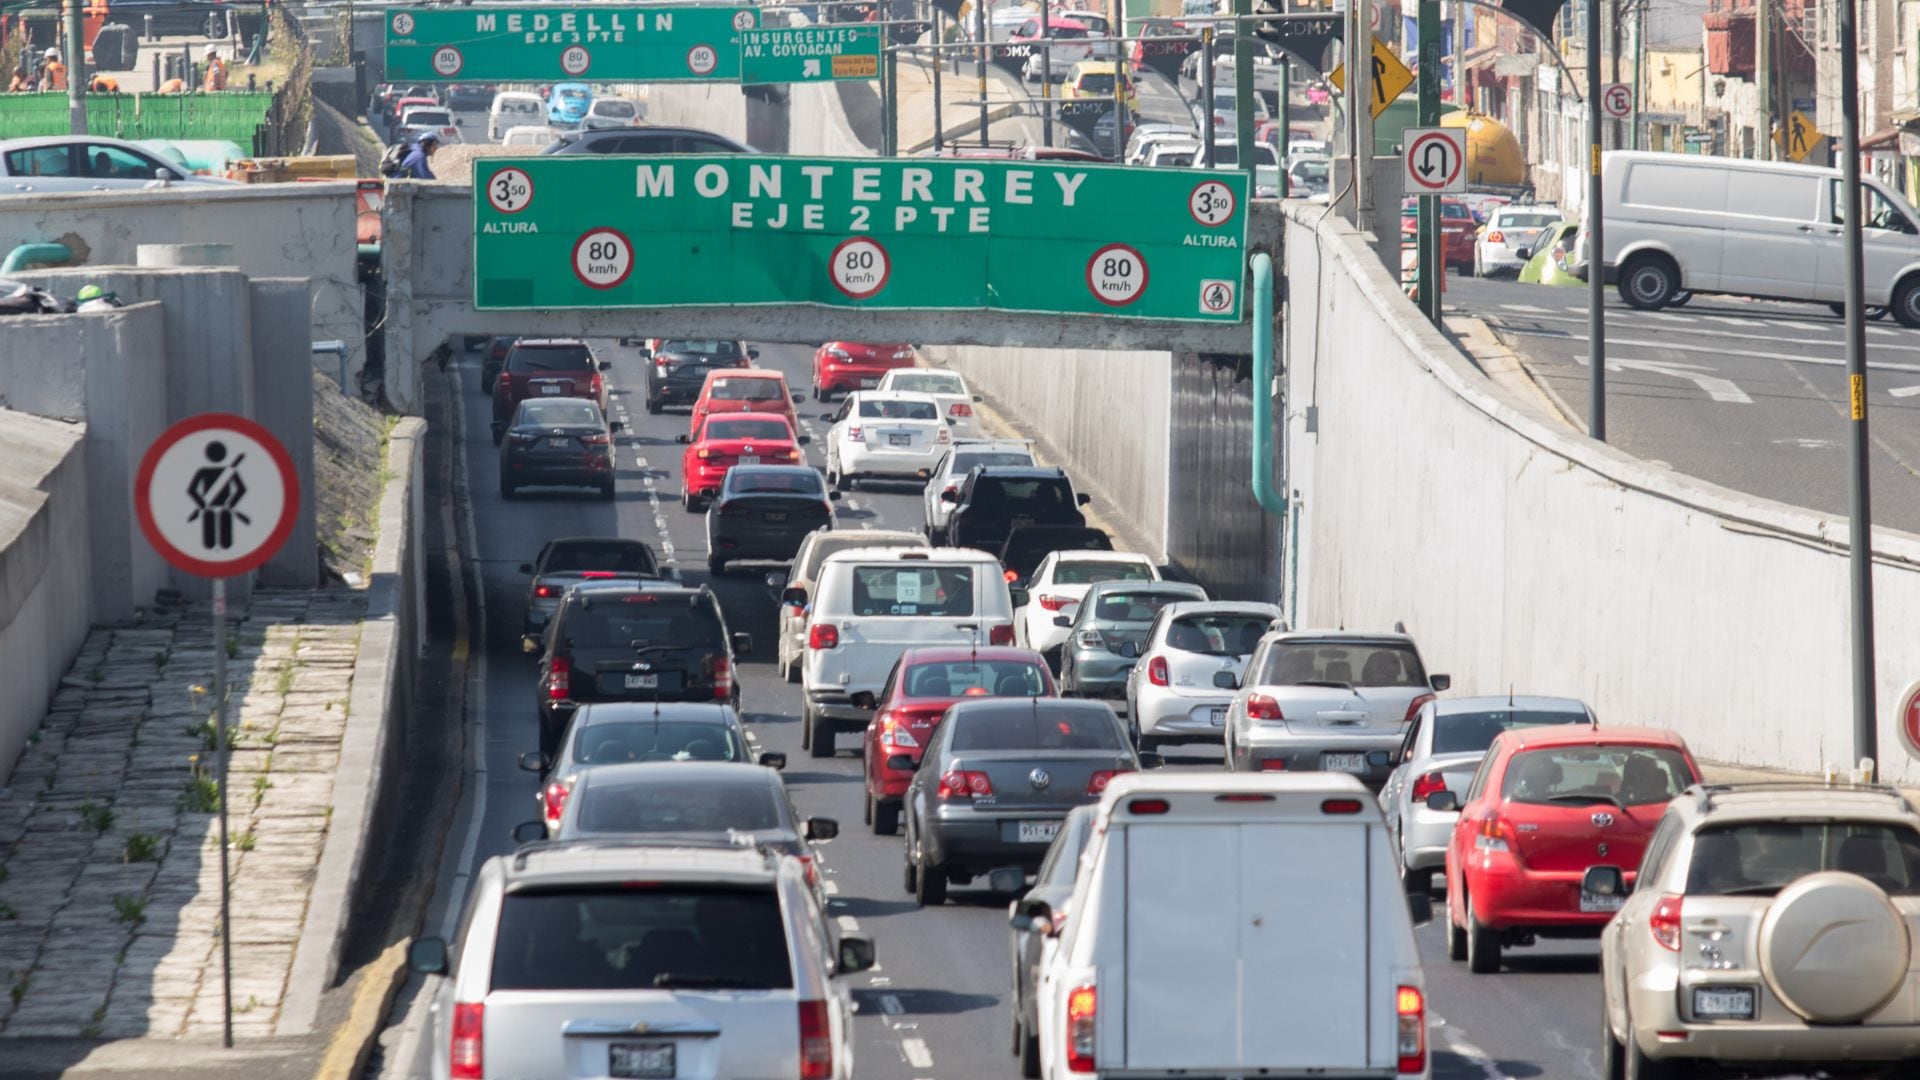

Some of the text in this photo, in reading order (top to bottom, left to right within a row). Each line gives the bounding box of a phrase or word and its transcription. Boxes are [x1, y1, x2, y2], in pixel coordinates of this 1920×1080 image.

[476, 13, 673, 32] MEDELLIN
[525, 31, 624, 44] EJE 3 PTE
[772, 43, 842, 57] COYOACAN
[994, 45, 1031, 57] CDMX
[1143, 42, 1189, 54] CDMX
[440, 52, 455, 63] 80
[569, 52, 583, 62] 80
[694, 51, 708, 61] 80
[1062, 103, 1103, 115] CDMX
[636, 164, 1088, 207] MONTERREY
[732, 202, 990, 232] EJE 2 PTE
[483, 222, 538, 233] ALTURA
[1183, 234, 1237, 248] ALTURA
[589, 241, 617, 260] 80
[846, 251, 873, 269] 80
[588, 263, 618, 274] km/h
[1103, 258, 1131, 278] 80
[845, 272, 875, 284] km/h
[1102, 280, 1131, 292] km/h
